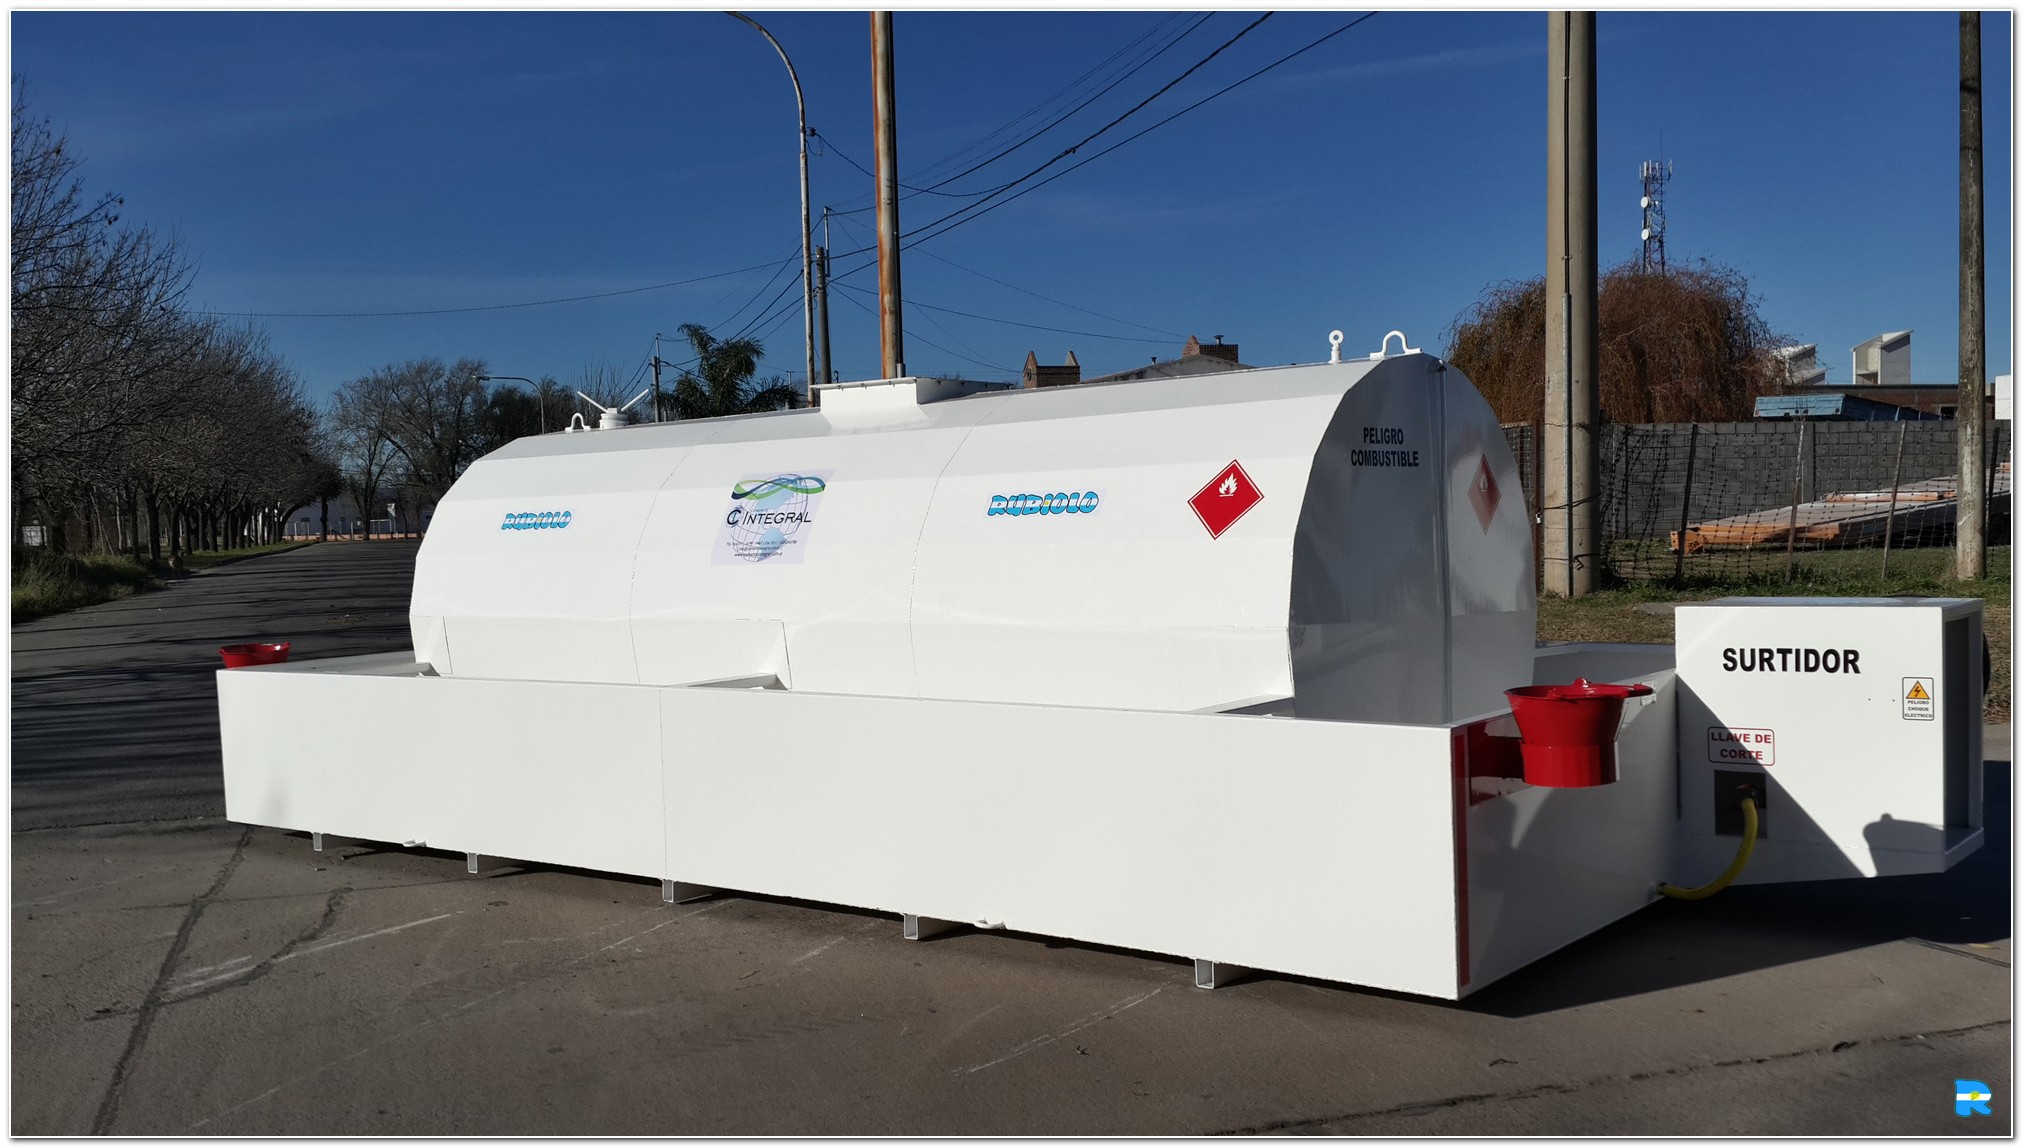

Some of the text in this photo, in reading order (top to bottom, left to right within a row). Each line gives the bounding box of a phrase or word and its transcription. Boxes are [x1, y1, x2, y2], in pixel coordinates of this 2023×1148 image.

[1363, 427, 1404, 445] PELIGRO
[1351, 449, 1419, 467] COMBUSTIBLE
[987, 491, 1100, 516] RUBIOLO
[501, 511, 571, 530] RUBIOLO
[742, 511, 812, 525] INTEGRAL
[1722, 648, 1861, 674] SURTIDOR
[1711, 732, 1772, 744] LLAVE DE
[1720, 749, 1763, 760] CORTE
